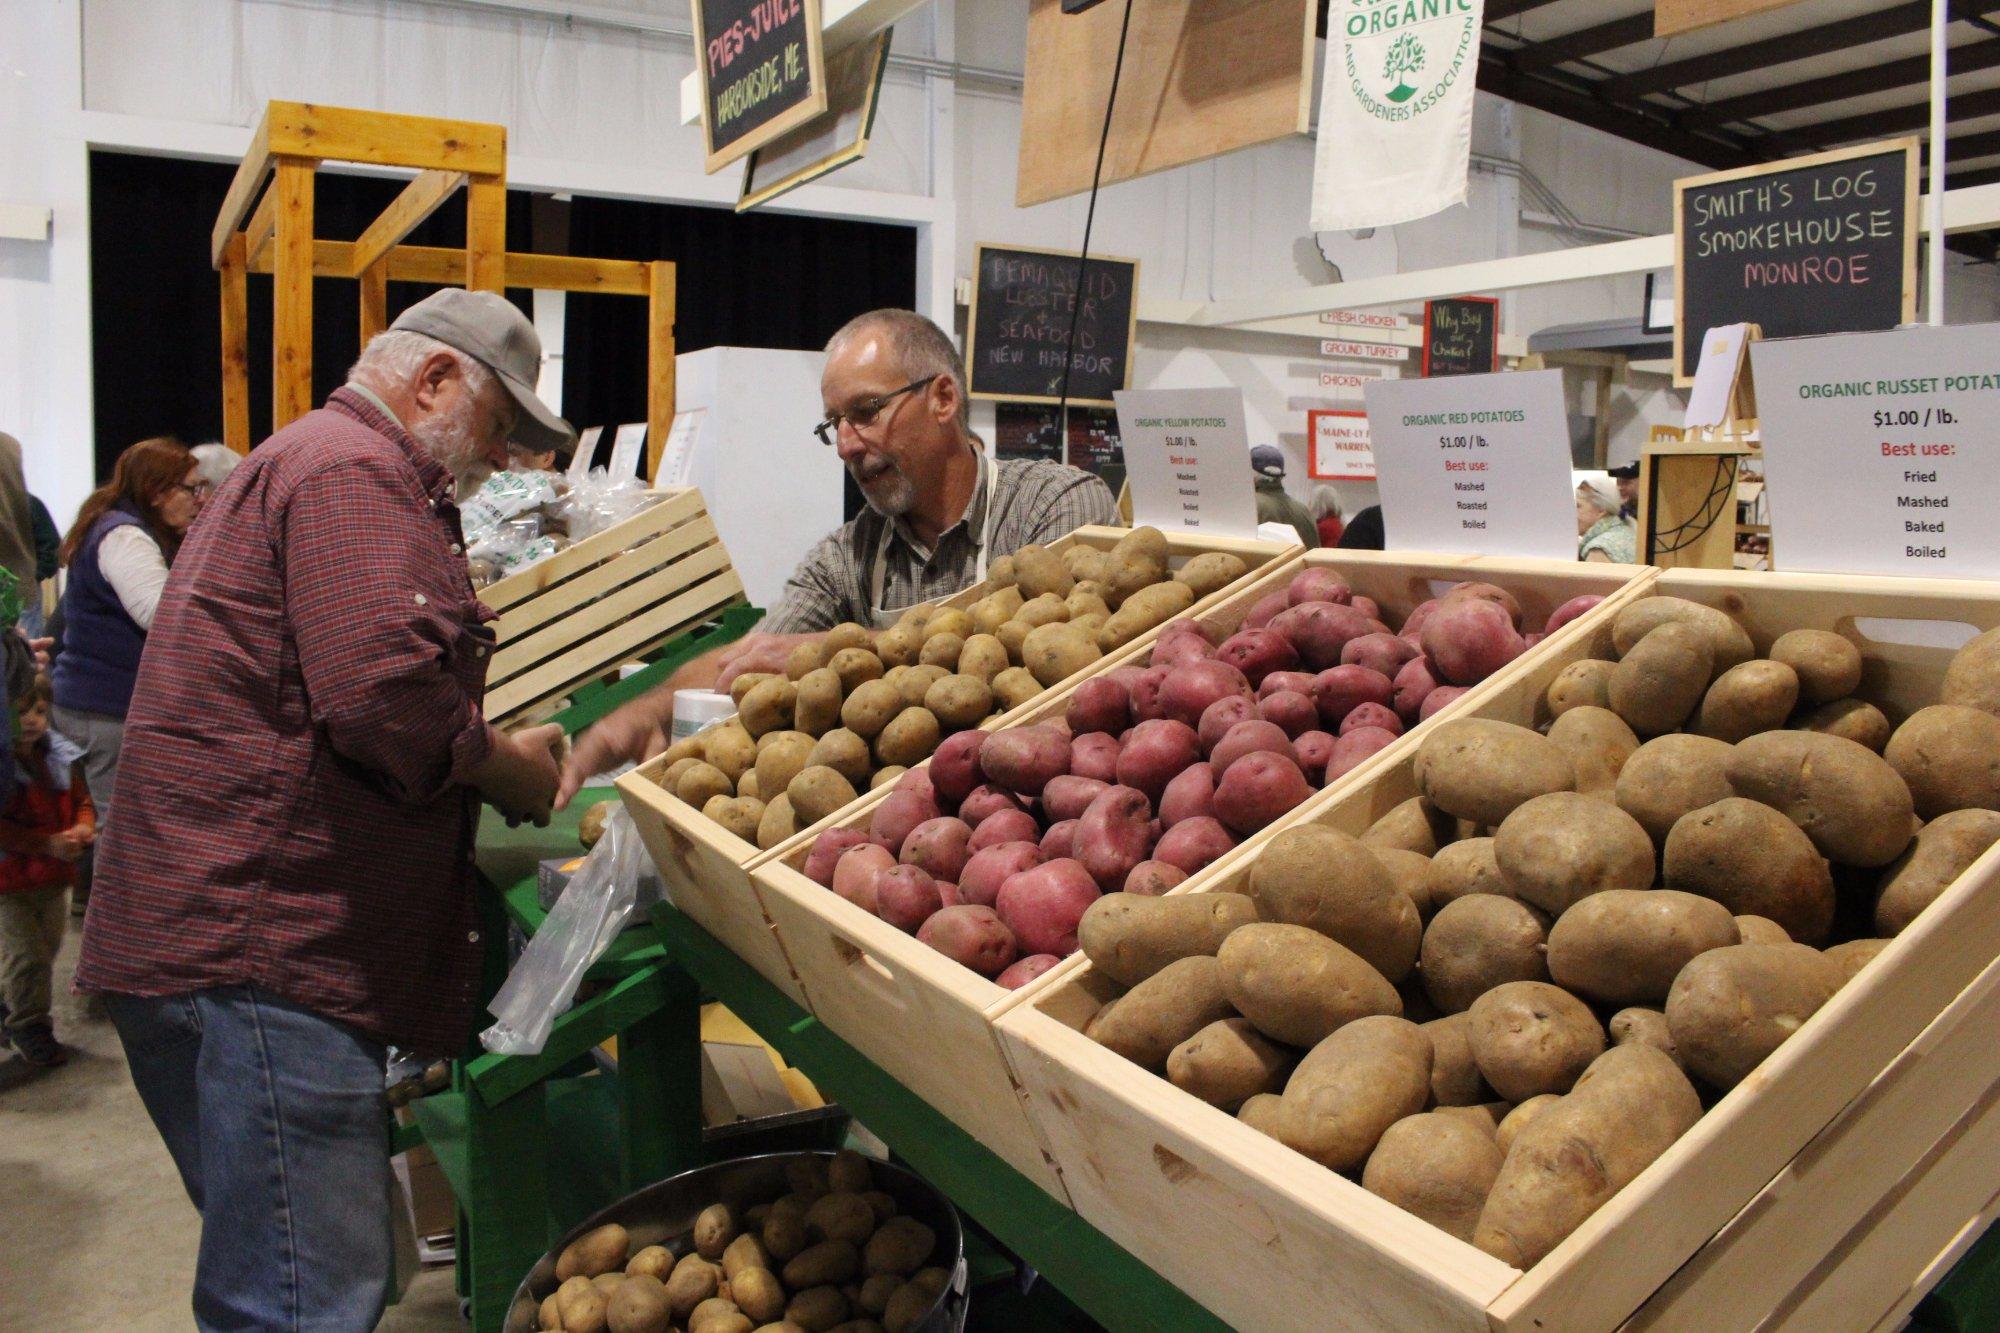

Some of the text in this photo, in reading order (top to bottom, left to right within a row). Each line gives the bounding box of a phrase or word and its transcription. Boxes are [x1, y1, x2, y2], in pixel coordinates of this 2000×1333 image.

[1347, 0, 1472, 36] ORGANIC
[1344, 16, 1474, 121] AND GARDENERS ASSOCIATION
[1694, 170, 1878, 227] SMITH'S LOG
[1697, 209, 1892, 257] SMOKEHOUSE
[1744, 254, 1871, 289] MONROE
[1327, 311, 1397, 326] FRESH CHICKEN
[1432, 305, 1459, 334] Why
[990, 344, 1024, 364] NEW
[1325, 342, 1400, 358] GROUND TURKEY
[1322, 374, 1362, 387] CHICKEN
[1799, 381, 1872, 399] ORGANIC
[1877, 377, 1939, 395] RUSSET
[1134, 418, 1226, 427] ORGANIC YELLOW POTATOES
[1402, 410, 1525, 426] ORGANIC RED POTATOES
[1873, 408, 1958, 428] $1.00 / lb.
[1440, 436, 1466, 449] $1.00
[1476, 436, 1489, 447] lb.
[1881, 442, 1956, 456] Best use:
[1169, 455, 1183, 464] Best
[1445, 460, 1489, 471] Best use:
[1904, 471, 1937, 482] Fried
[1454, 482, 1485, 492] Mashed
[1457, 501, 1488, 510] Roasted
[1897, 496, 1949, 508] Mashed
[1462, 520, 1486, 529] Boiled
[1905, 521, 1945, 532] Baked
[1906, 545, 1946, 558] Boiled
